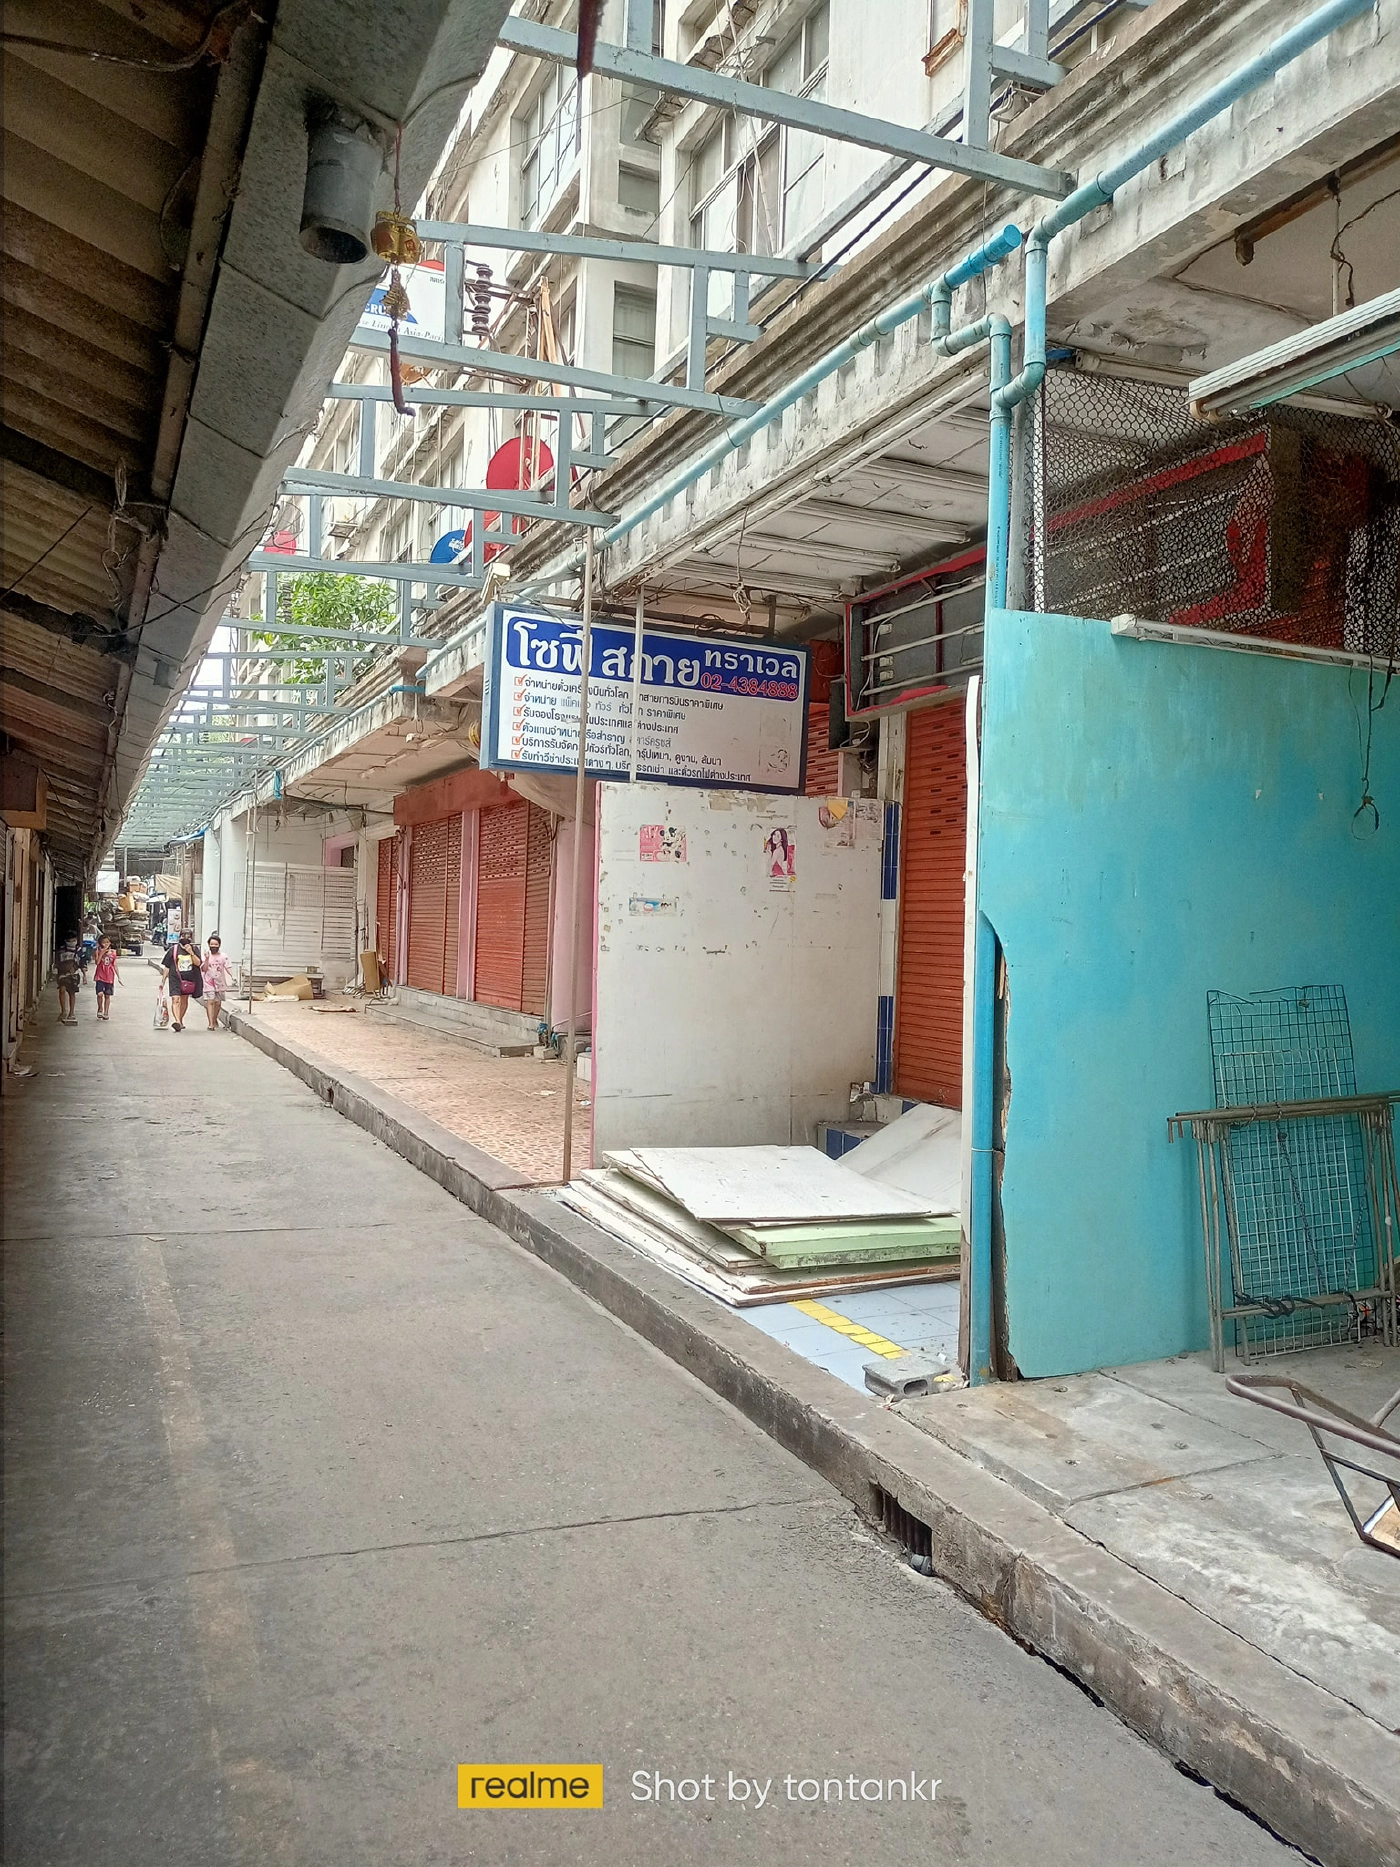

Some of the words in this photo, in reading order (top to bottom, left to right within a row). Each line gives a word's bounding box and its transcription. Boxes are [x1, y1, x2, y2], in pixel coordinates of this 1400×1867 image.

[602, 646, 699, 686] สกาย
[705, 650, 797, 678] ทราเวล
[701, 674, 798, 698] 02-4384888
